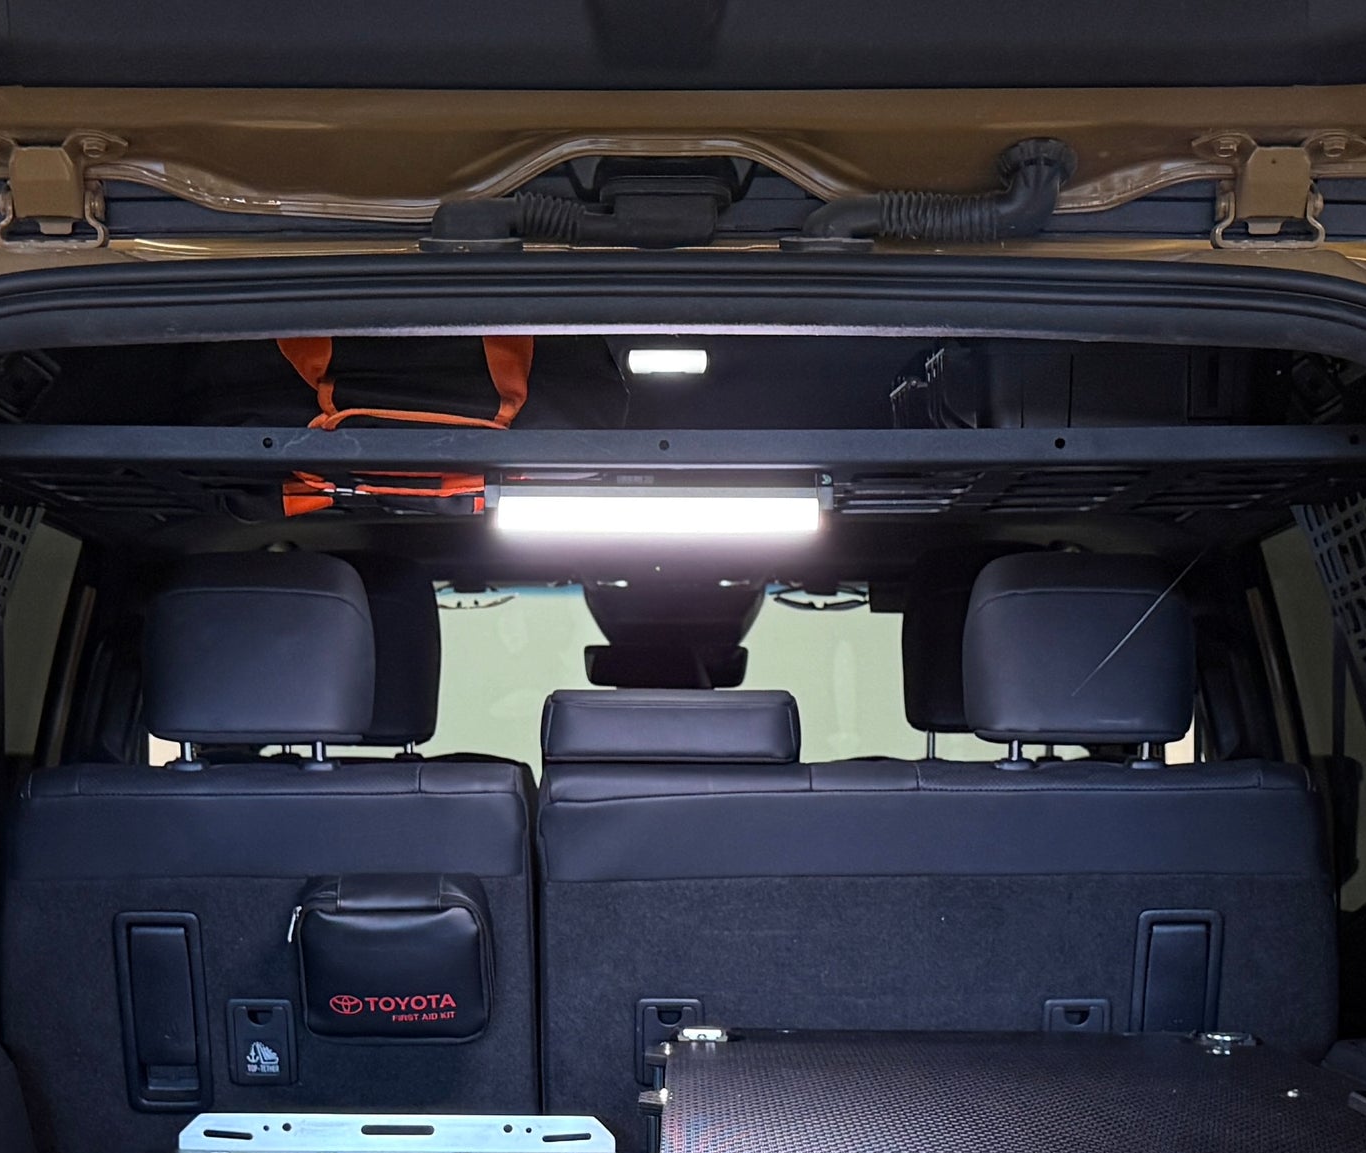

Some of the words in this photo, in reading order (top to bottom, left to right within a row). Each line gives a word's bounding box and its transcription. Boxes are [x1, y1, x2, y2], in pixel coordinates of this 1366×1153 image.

[364, 993, 457, 1013] TOYOTA
[392, 1013, 419, 1023] FIRST
[421, 1012, 439, 1022] AID
[440, 1011, 456, 1020] KIT
